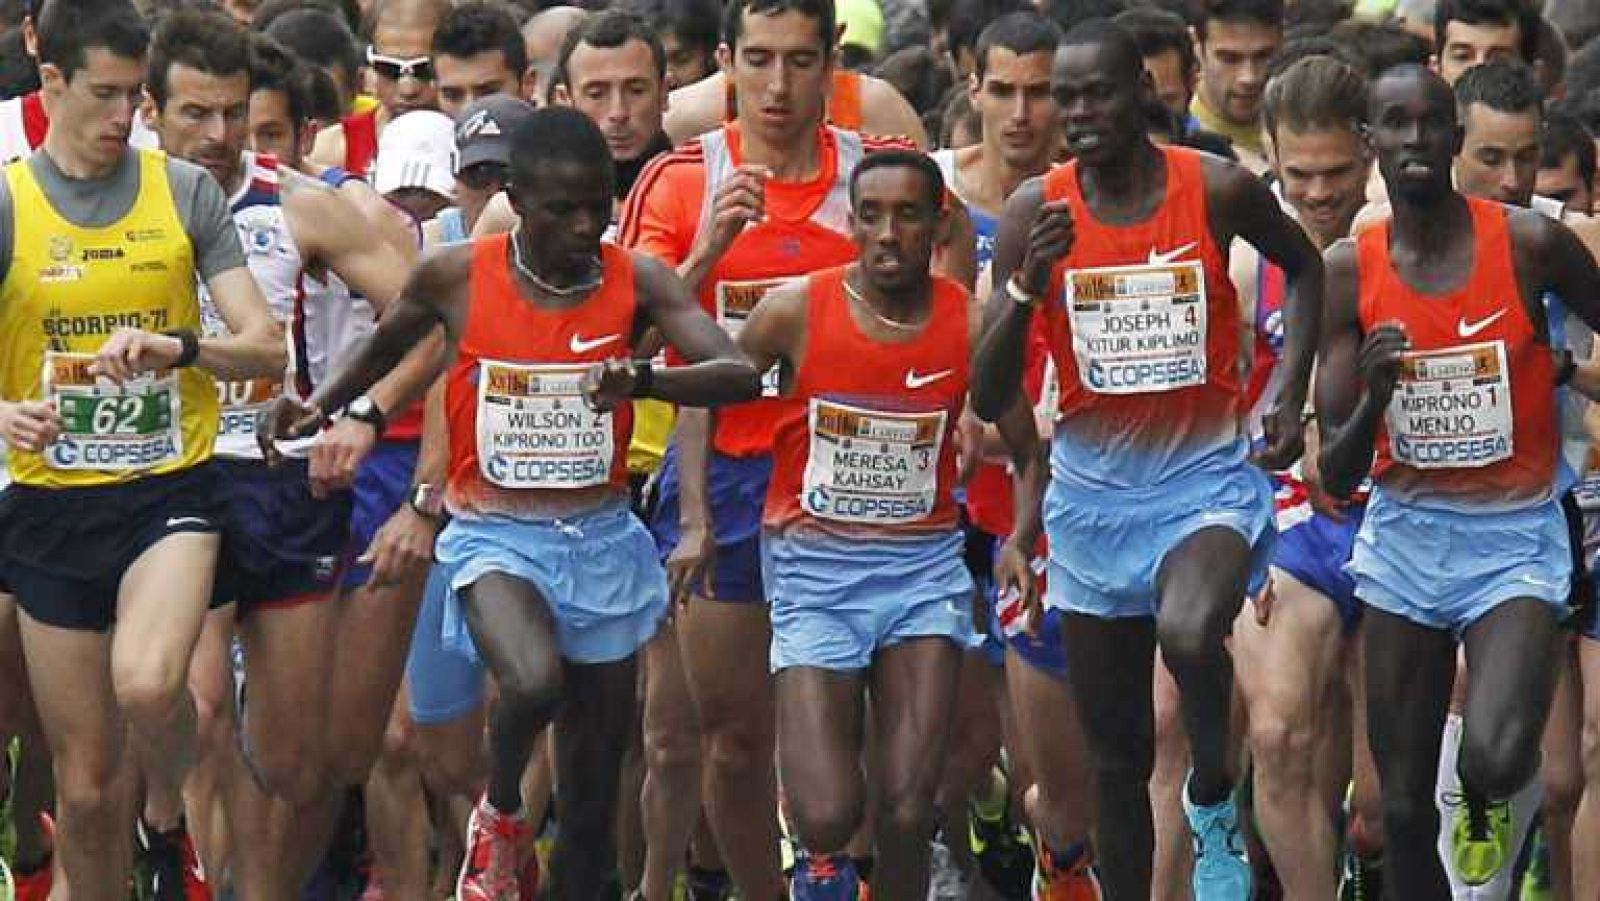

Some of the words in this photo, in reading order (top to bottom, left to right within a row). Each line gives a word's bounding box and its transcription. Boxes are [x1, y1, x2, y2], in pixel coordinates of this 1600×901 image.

[1100, 313, 1171, 334] JOSEPH
[1184, 305, 1198, 327] 4
[1086, 337, 1131, 354] KITUR
[1137, 331, 1199, 352] KIPLIMO
[1109, 359, 1204, 387] COPSESA
[1402, 392, 1481, 412] KIPRONO
[1486, 387, 1497, 408] 1
[93, 396, 144, 435] 62
[507, 412, 582, 429] WILSON
[1409, 415, 1476, 434] MENJO
[494, 433, 566, 449] KIPRONO
[574, 432, 605, 447] TOO
[1414, 436, 1507, 461] COPSESA
[84, 441, 176, 464] COPSESA
[832, 450, 908, 471] MERESA
[918, 449, 931, 471] 3
[514, 460, 605, 481] COPSESA
[832, 471, 906, 488] KAHSAY
[833, 496, 927, 518] COPSESA
